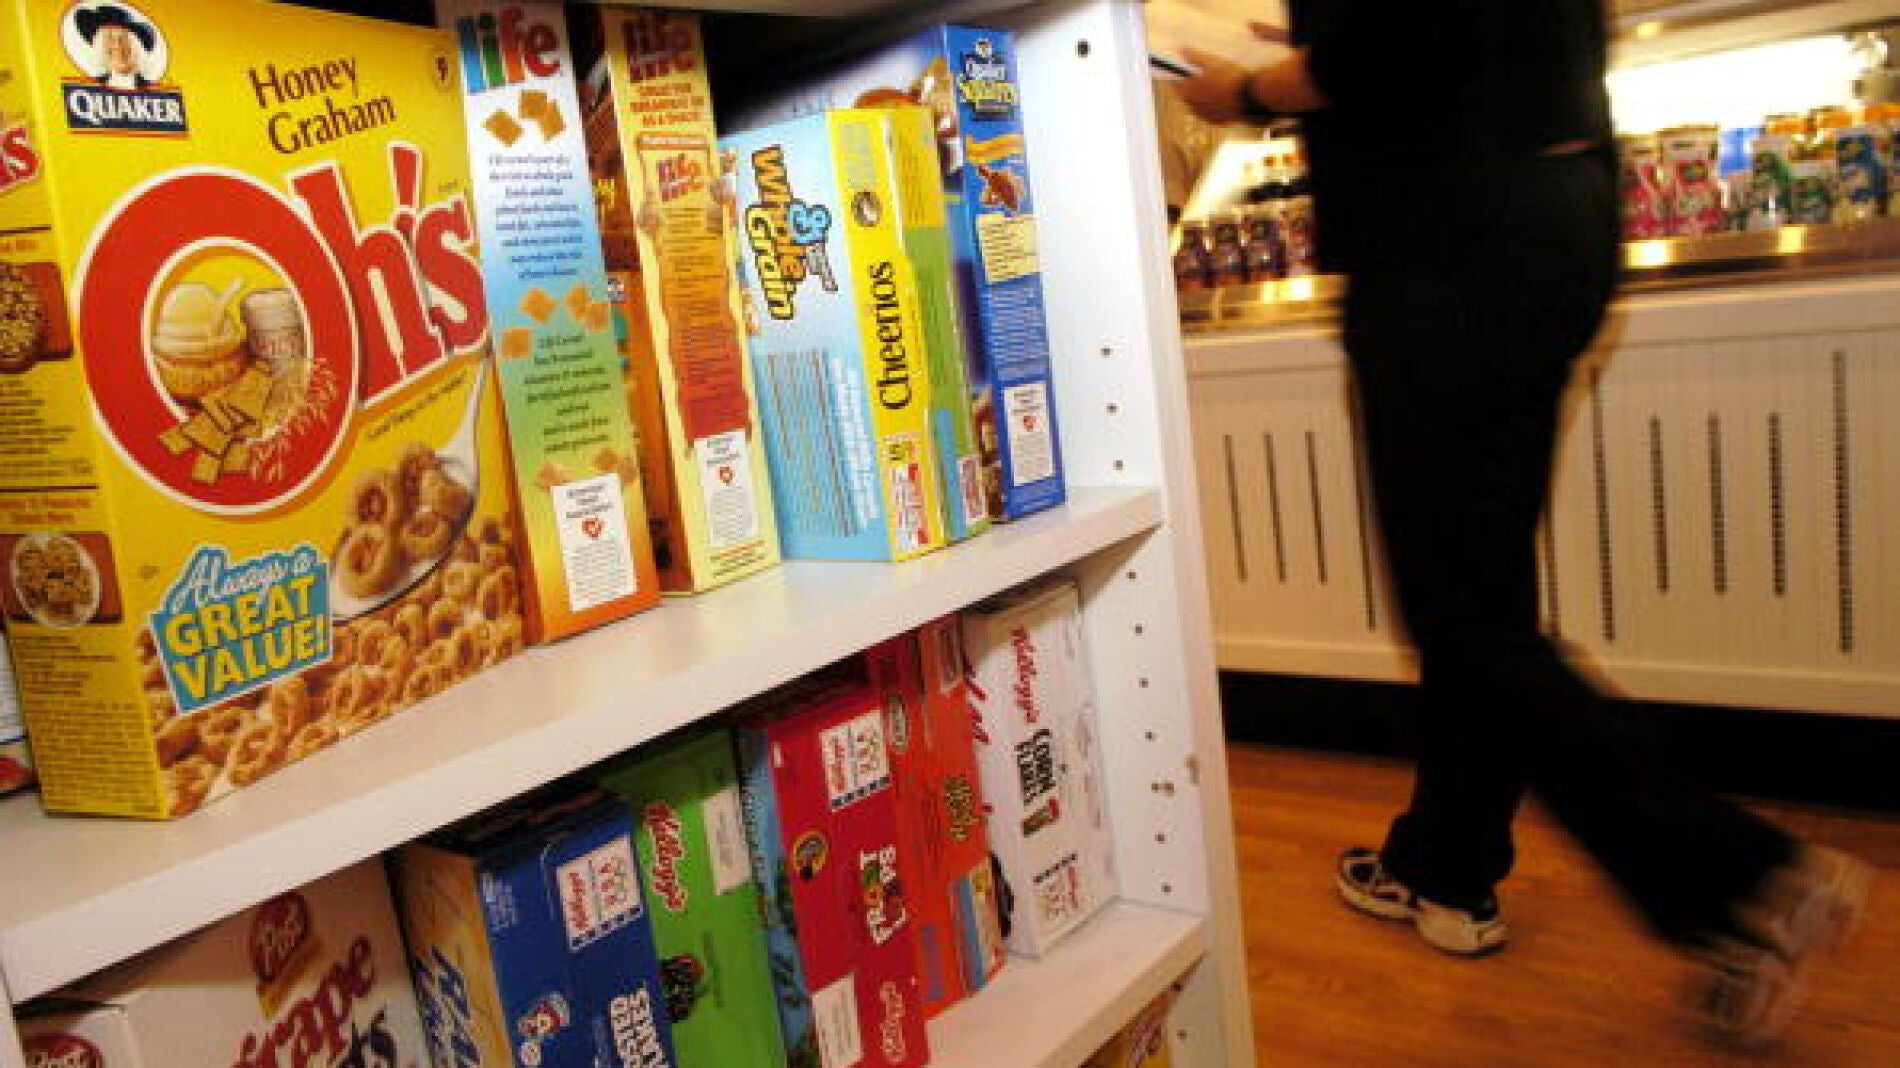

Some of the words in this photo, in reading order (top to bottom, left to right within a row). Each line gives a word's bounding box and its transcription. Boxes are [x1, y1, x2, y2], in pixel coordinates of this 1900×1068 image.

[248, 56, 358, 109] Honey
[458, 7, 560, 93] life
[69, 89, 183, 126] QUAKER
[267, 95, 396, 154] Graham
[746, 205, 796, 321] Grain
[76, 142, 487, 510] Oh's
[870, 261, 912, 410] Cheerios
[165, 576, 316, 656] GREAT
[173, 615, 326, 698] VALUE!
